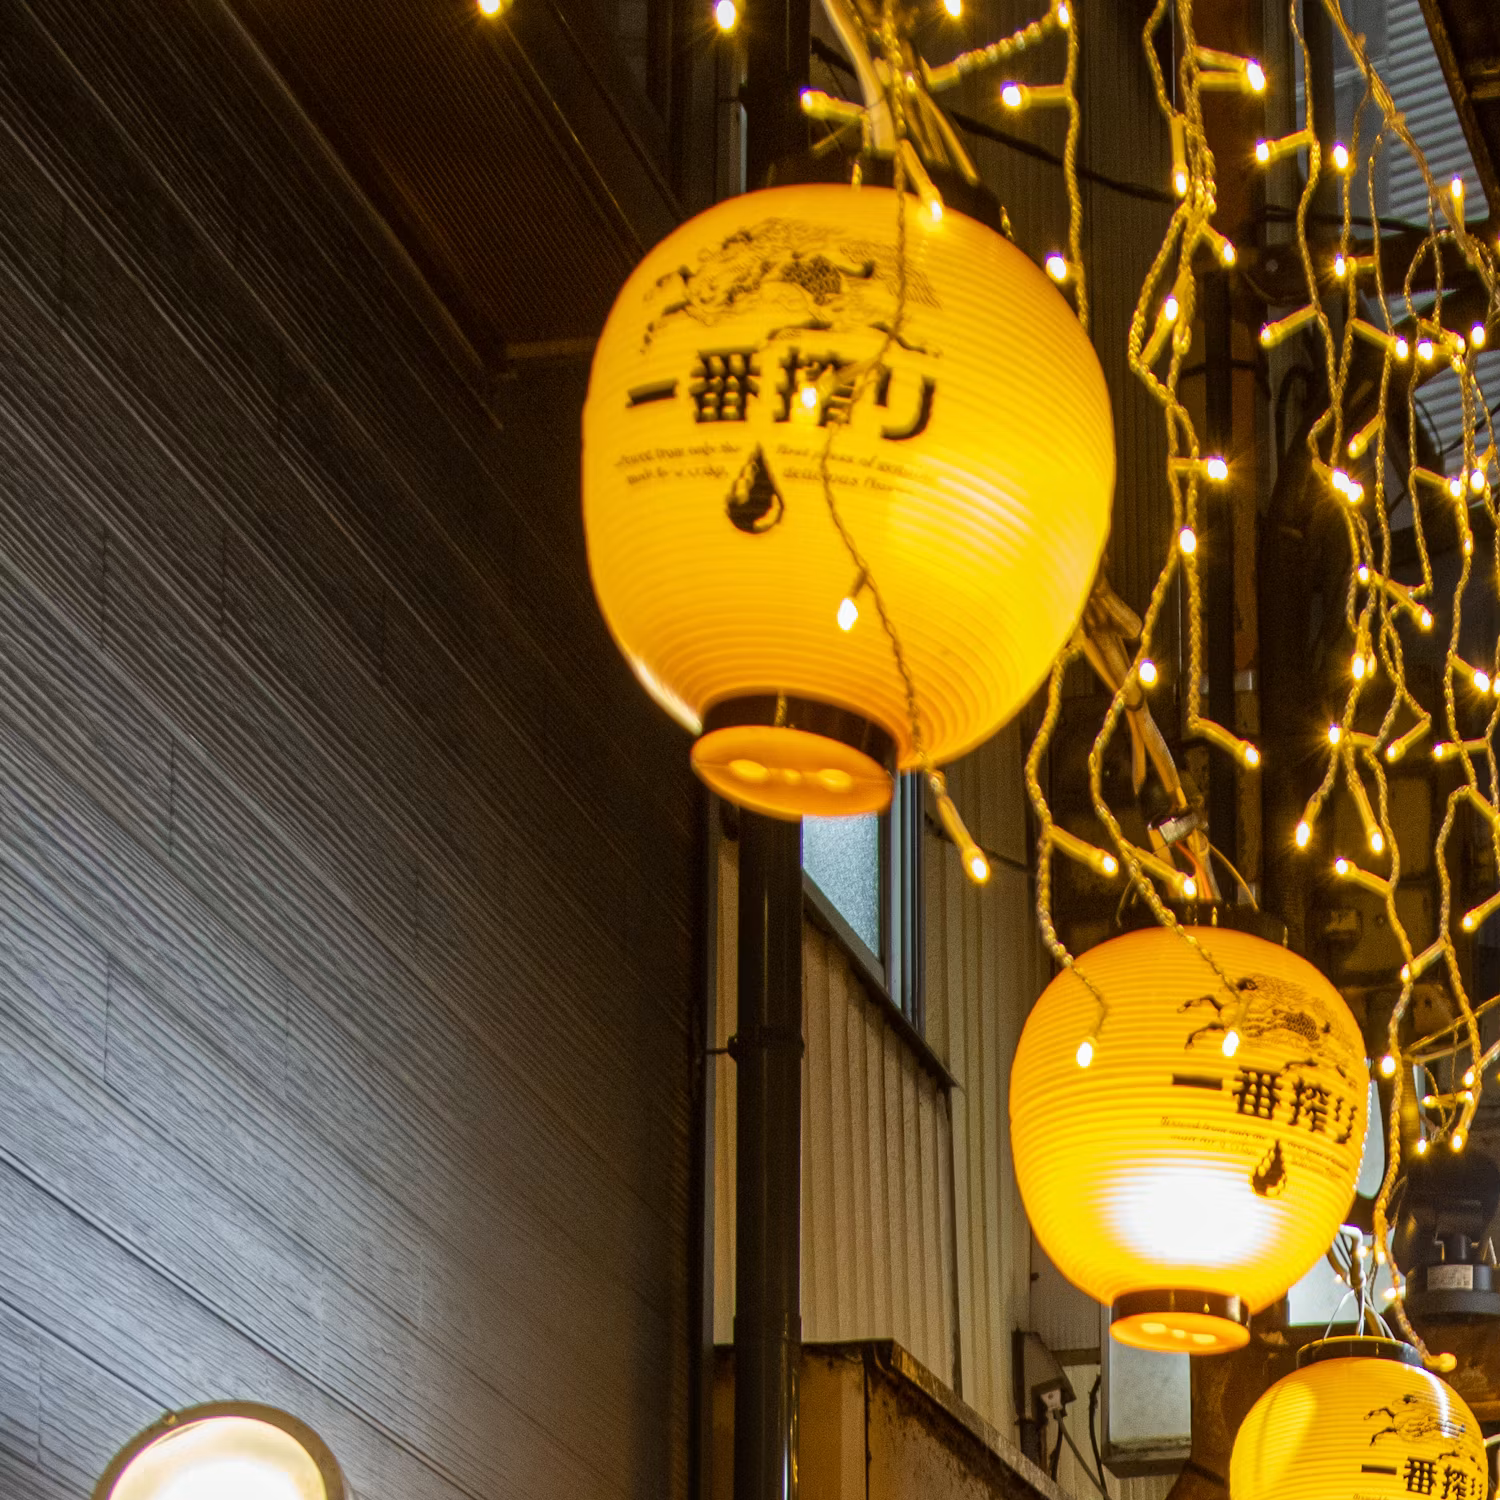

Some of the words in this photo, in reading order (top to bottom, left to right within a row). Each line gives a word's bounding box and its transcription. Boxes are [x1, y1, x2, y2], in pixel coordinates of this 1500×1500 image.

[626, 347, 936, 441] 一番搾り
[1172, 1064, 1357, 1145] 一番搾り
